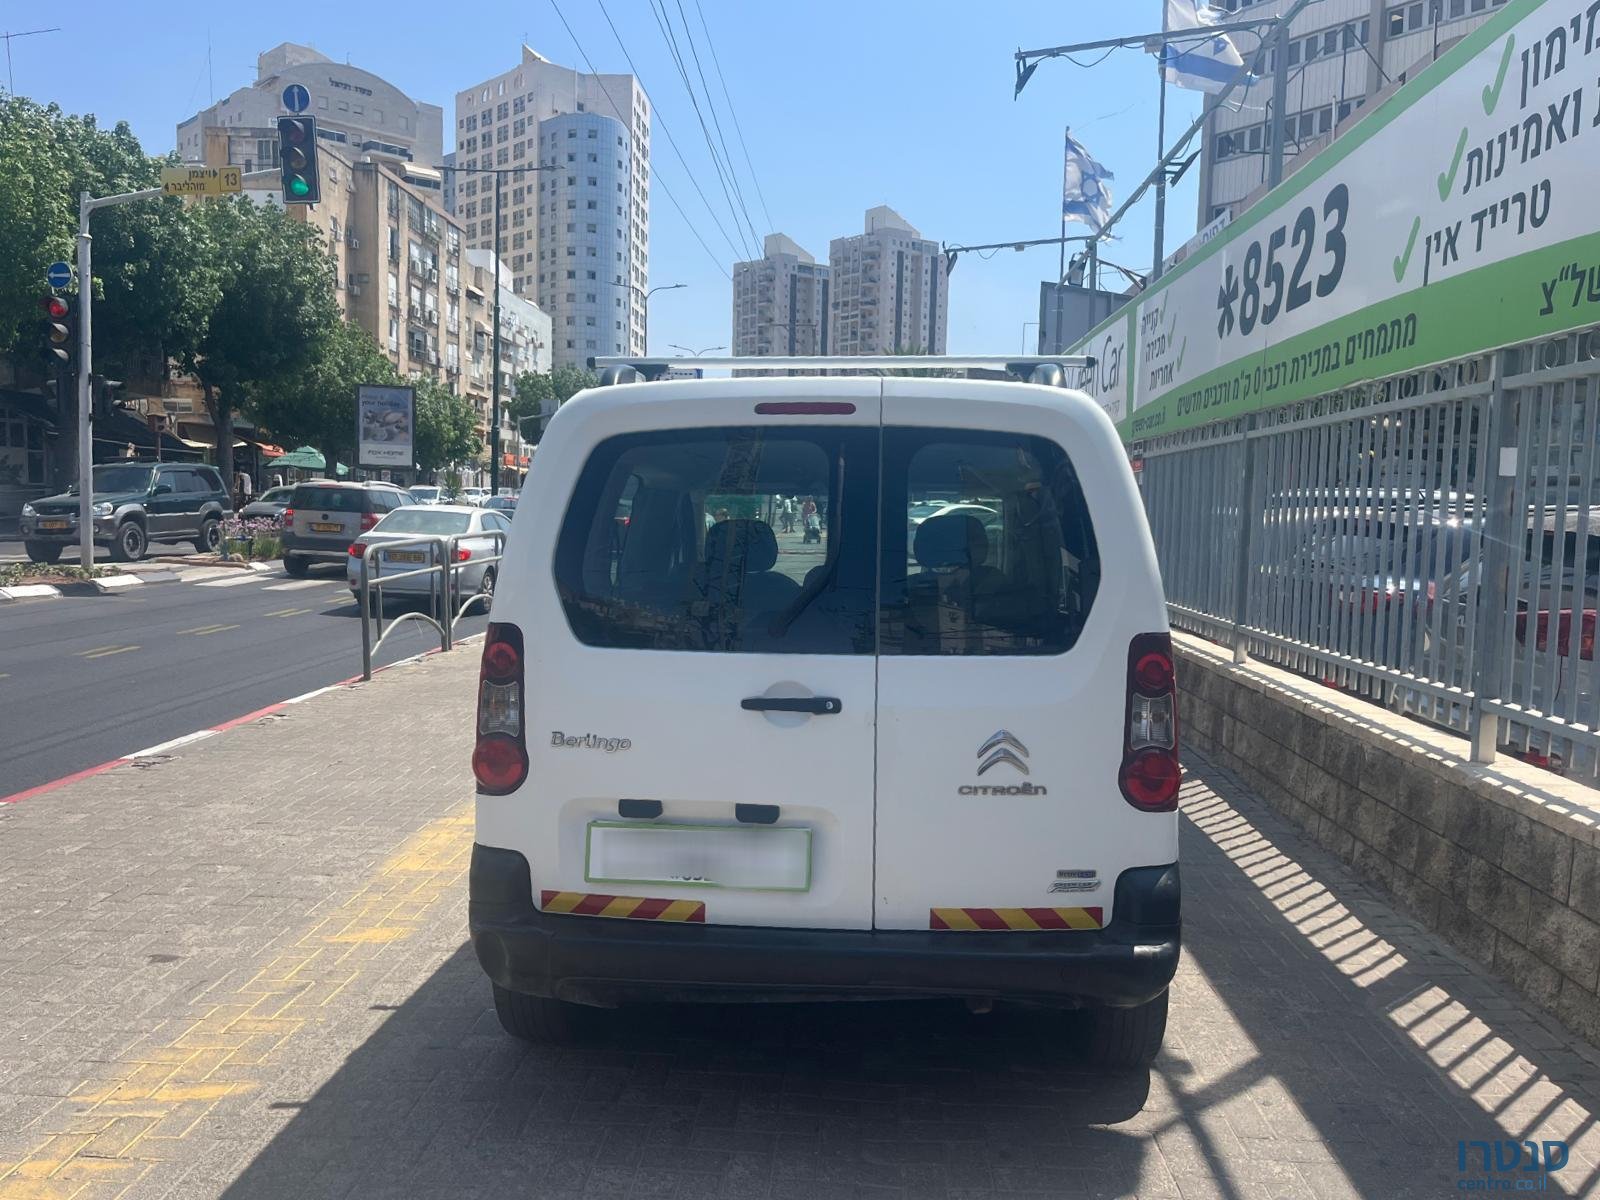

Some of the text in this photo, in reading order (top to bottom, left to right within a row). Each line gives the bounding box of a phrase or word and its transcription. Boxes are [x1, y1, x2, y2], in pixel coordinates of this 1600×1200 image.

[1463, 87, 1582, 195] ואמינות
[171, 180, 206, 191] מוהליבר
[188, 169, 212, 181] ויצמן
[224, 173, 238, 186] 13
[1423, 179, 1551, 287] טרייד אין
[1145, 334, 1166, 362] מכירה
[1345, 312, 1417, 366] מתמחים
[1102, 335, 1124, 393] Car
[1149, 361, 1175, 391] אחריות
[1290, 342, 1341, 384] במכירת
[1177, 391, 1201, 416] חדשים
[551, 731, 632, 753] Berlingo
